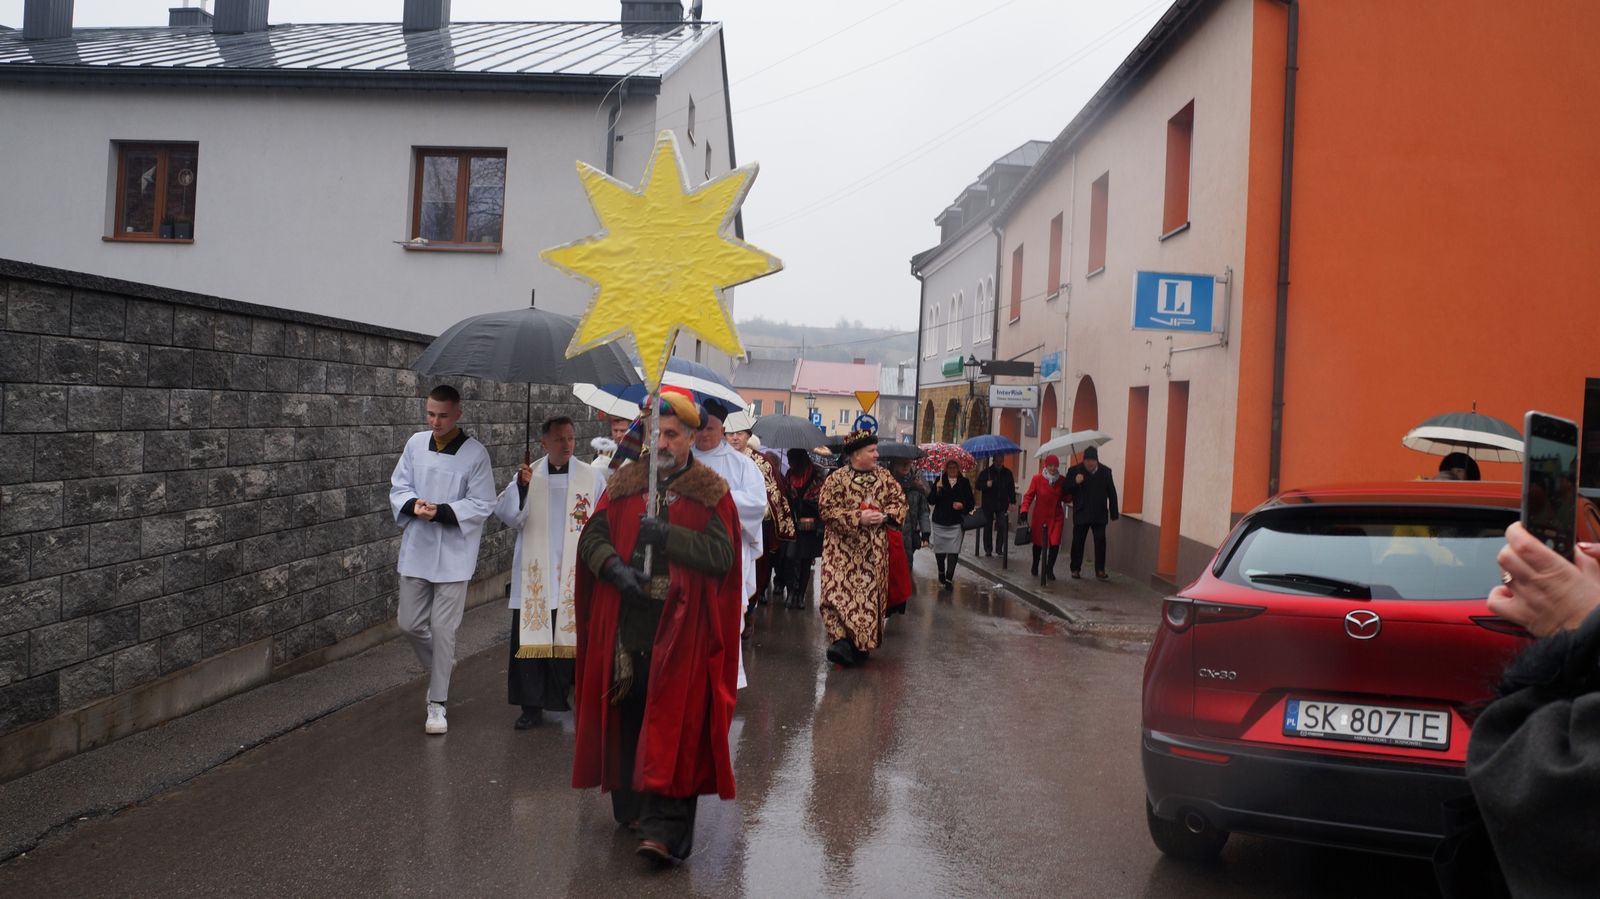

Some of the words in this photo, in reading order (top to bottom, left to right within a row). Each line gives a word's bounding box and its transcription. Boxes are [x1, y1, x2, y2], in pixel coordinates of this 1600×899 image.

[1163, 281, 1185, 312] L
[996, 388, 1023, 396] InterRisk
[813, 414, 820, 425] P
[1199, 668, 1236, 680] CX-30
[1286, 719, 1296, 727] PL
[1304, 704, 1339, 731] SK
[1350, 707, 1441, 741] 807TE
